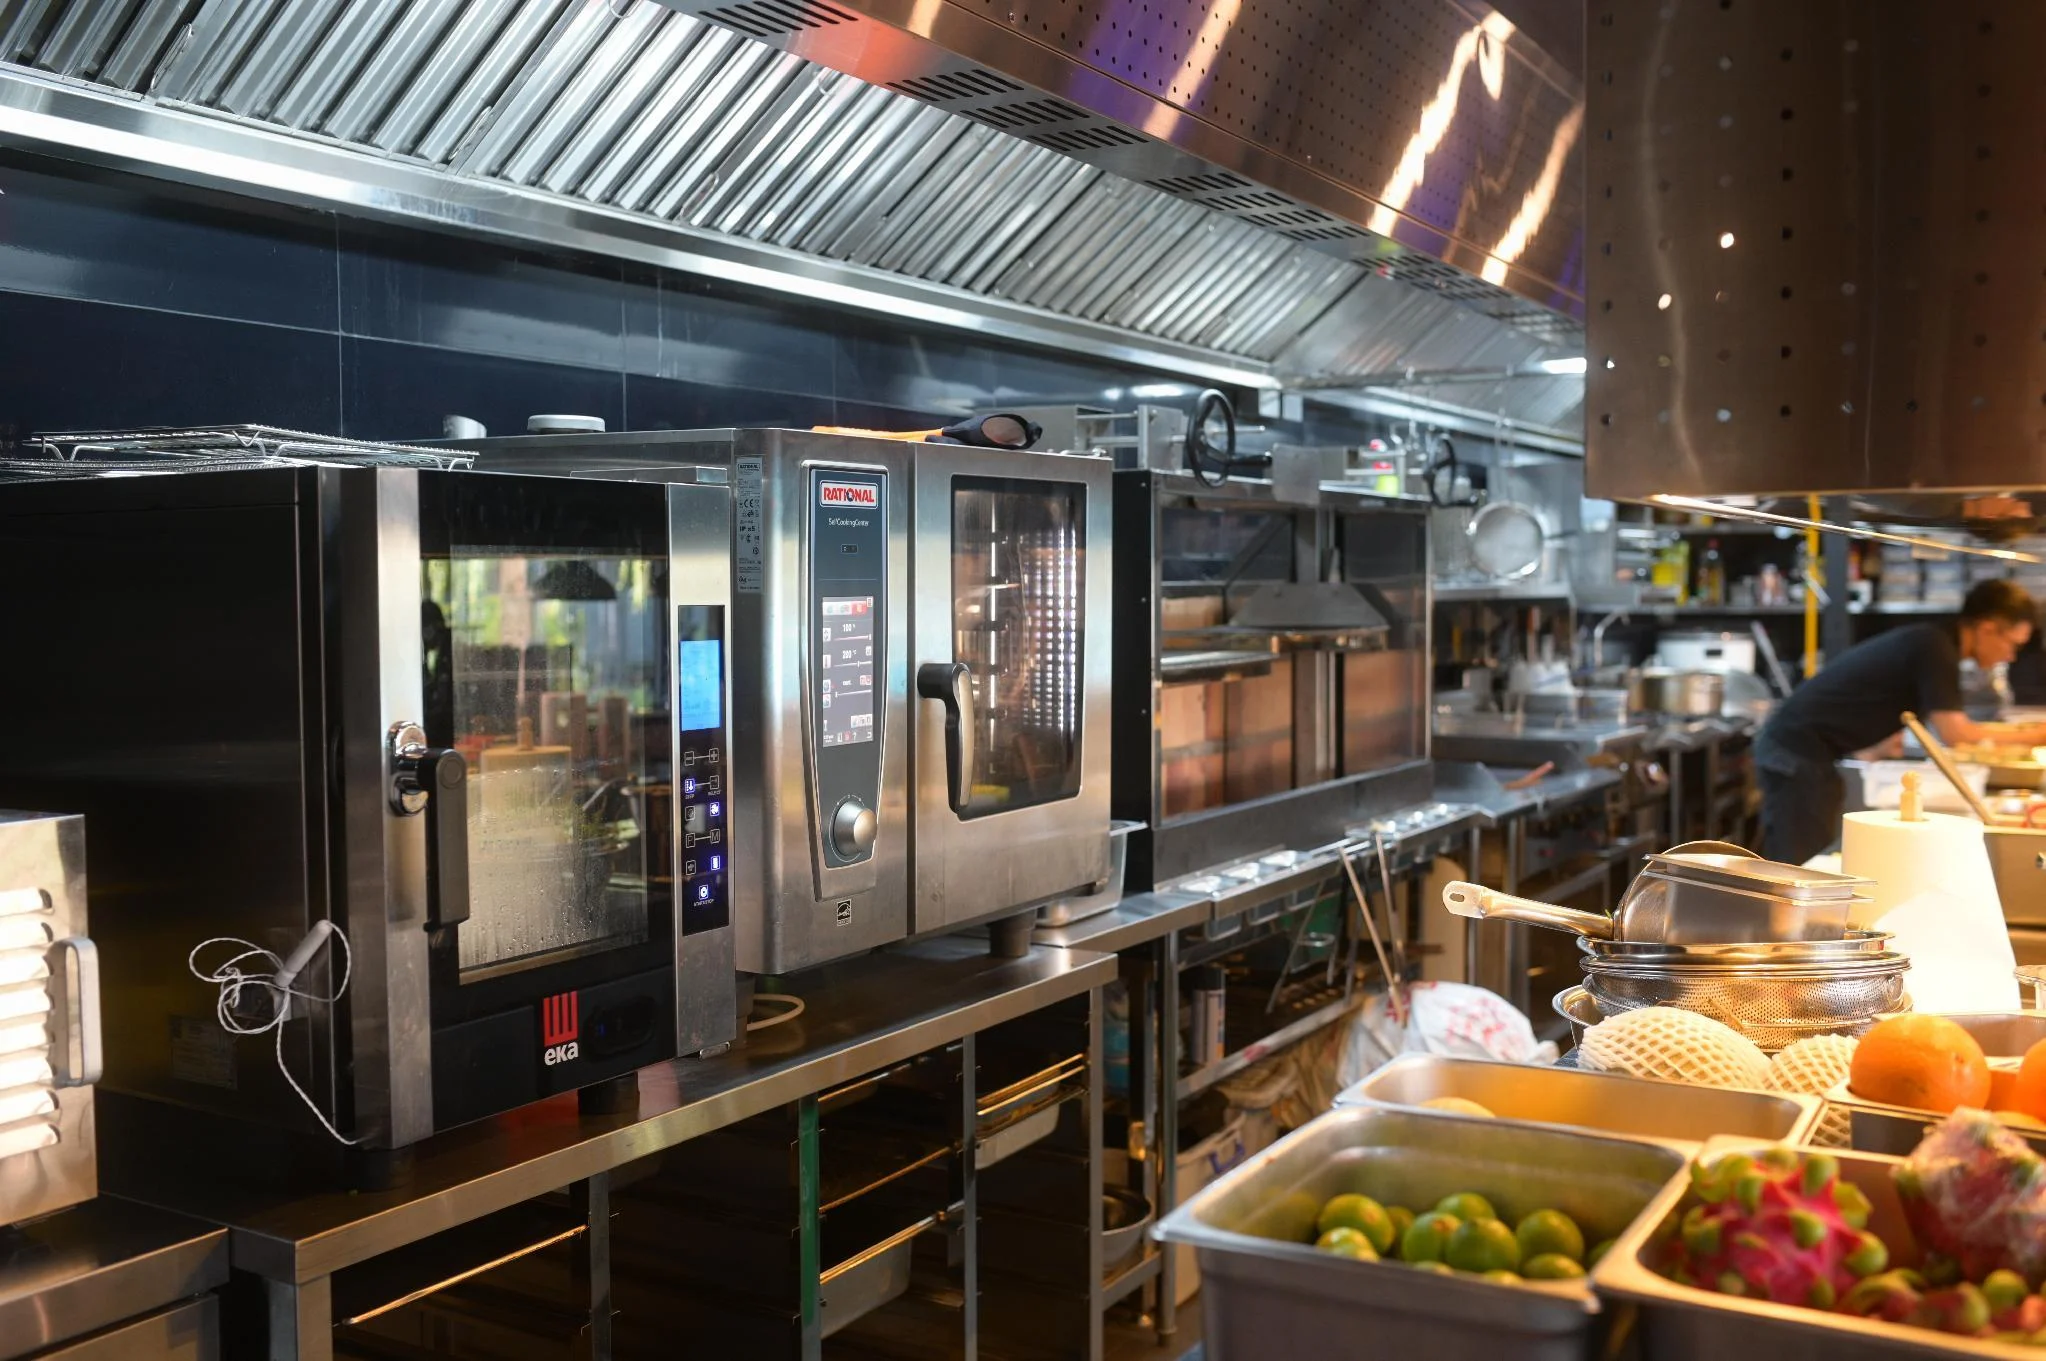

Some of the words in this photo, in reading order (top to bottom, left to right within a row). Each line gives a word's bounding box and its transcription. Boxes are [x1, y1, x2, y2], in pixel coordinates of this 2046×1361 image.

[823, 487, 875, 502] RATIONAL
[842, 623, 852, 632] 100
[688, 835, 693, 846] P
[711, 831, 719, 841] M
[544, 1041, 579, 1066] eka
